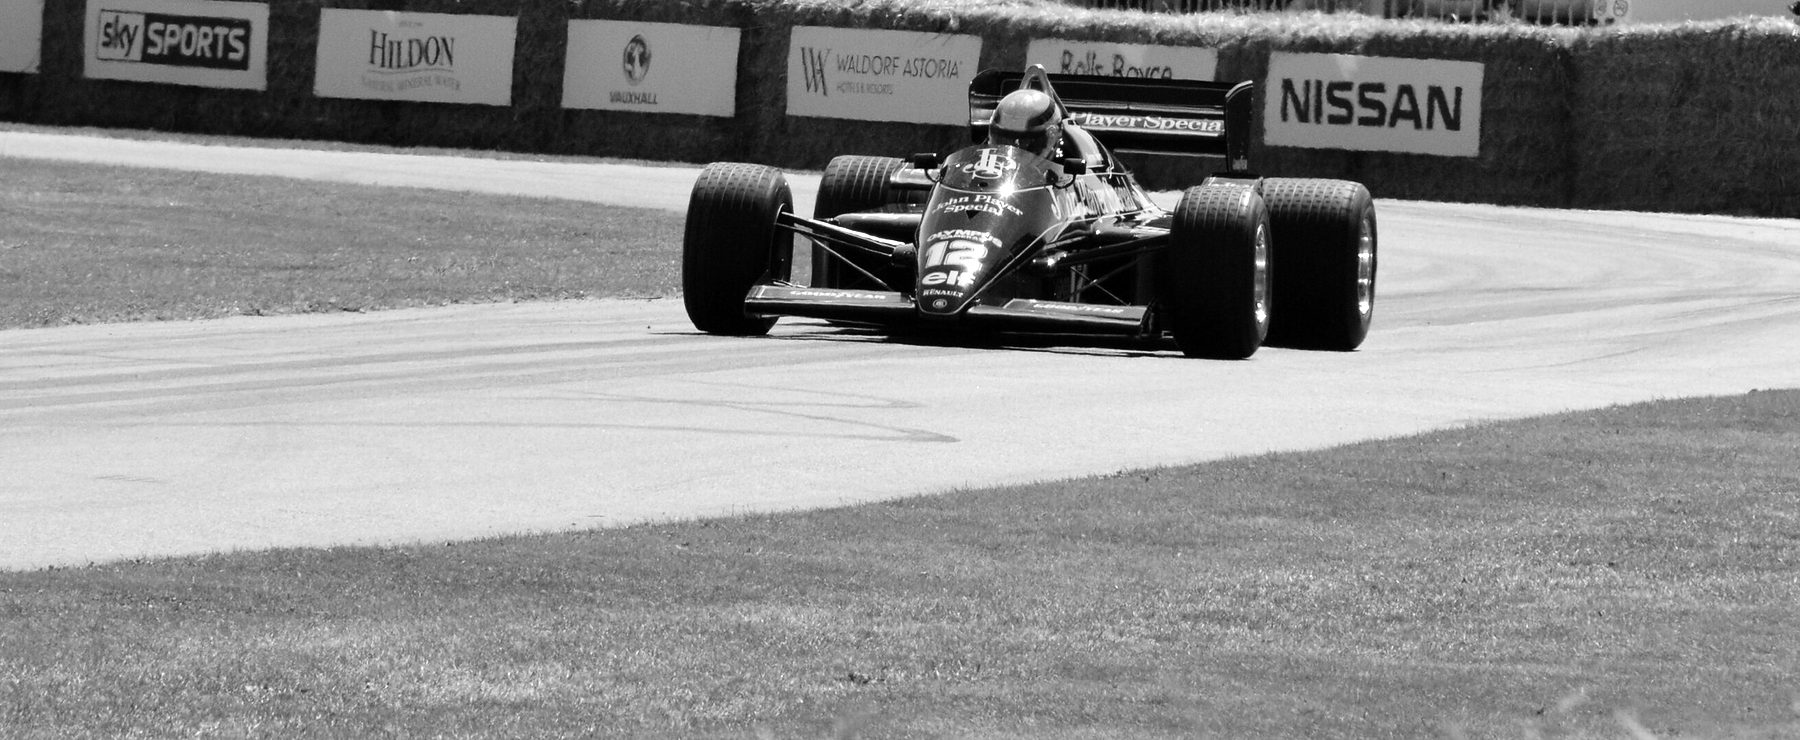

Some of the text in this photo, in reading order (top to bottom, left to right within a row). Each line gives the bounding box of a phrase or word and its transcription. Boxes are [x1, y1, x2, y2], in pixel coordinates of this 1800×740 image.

[101, 15, 246, 61] sky SPORTS
[369, 29, 455, 69] HILDON
[837, 54, 900, 76] WALDORF
[609, 91, 658, 105] VAUXHALL
[1280, 78, 1463, 131] NISSAN
[932, 195, 1024, 215] John Player
[925, 240, 988, 270] 12
[922, 270, 976, 287] elf
[923, 288, 964, 297] RENAULT
